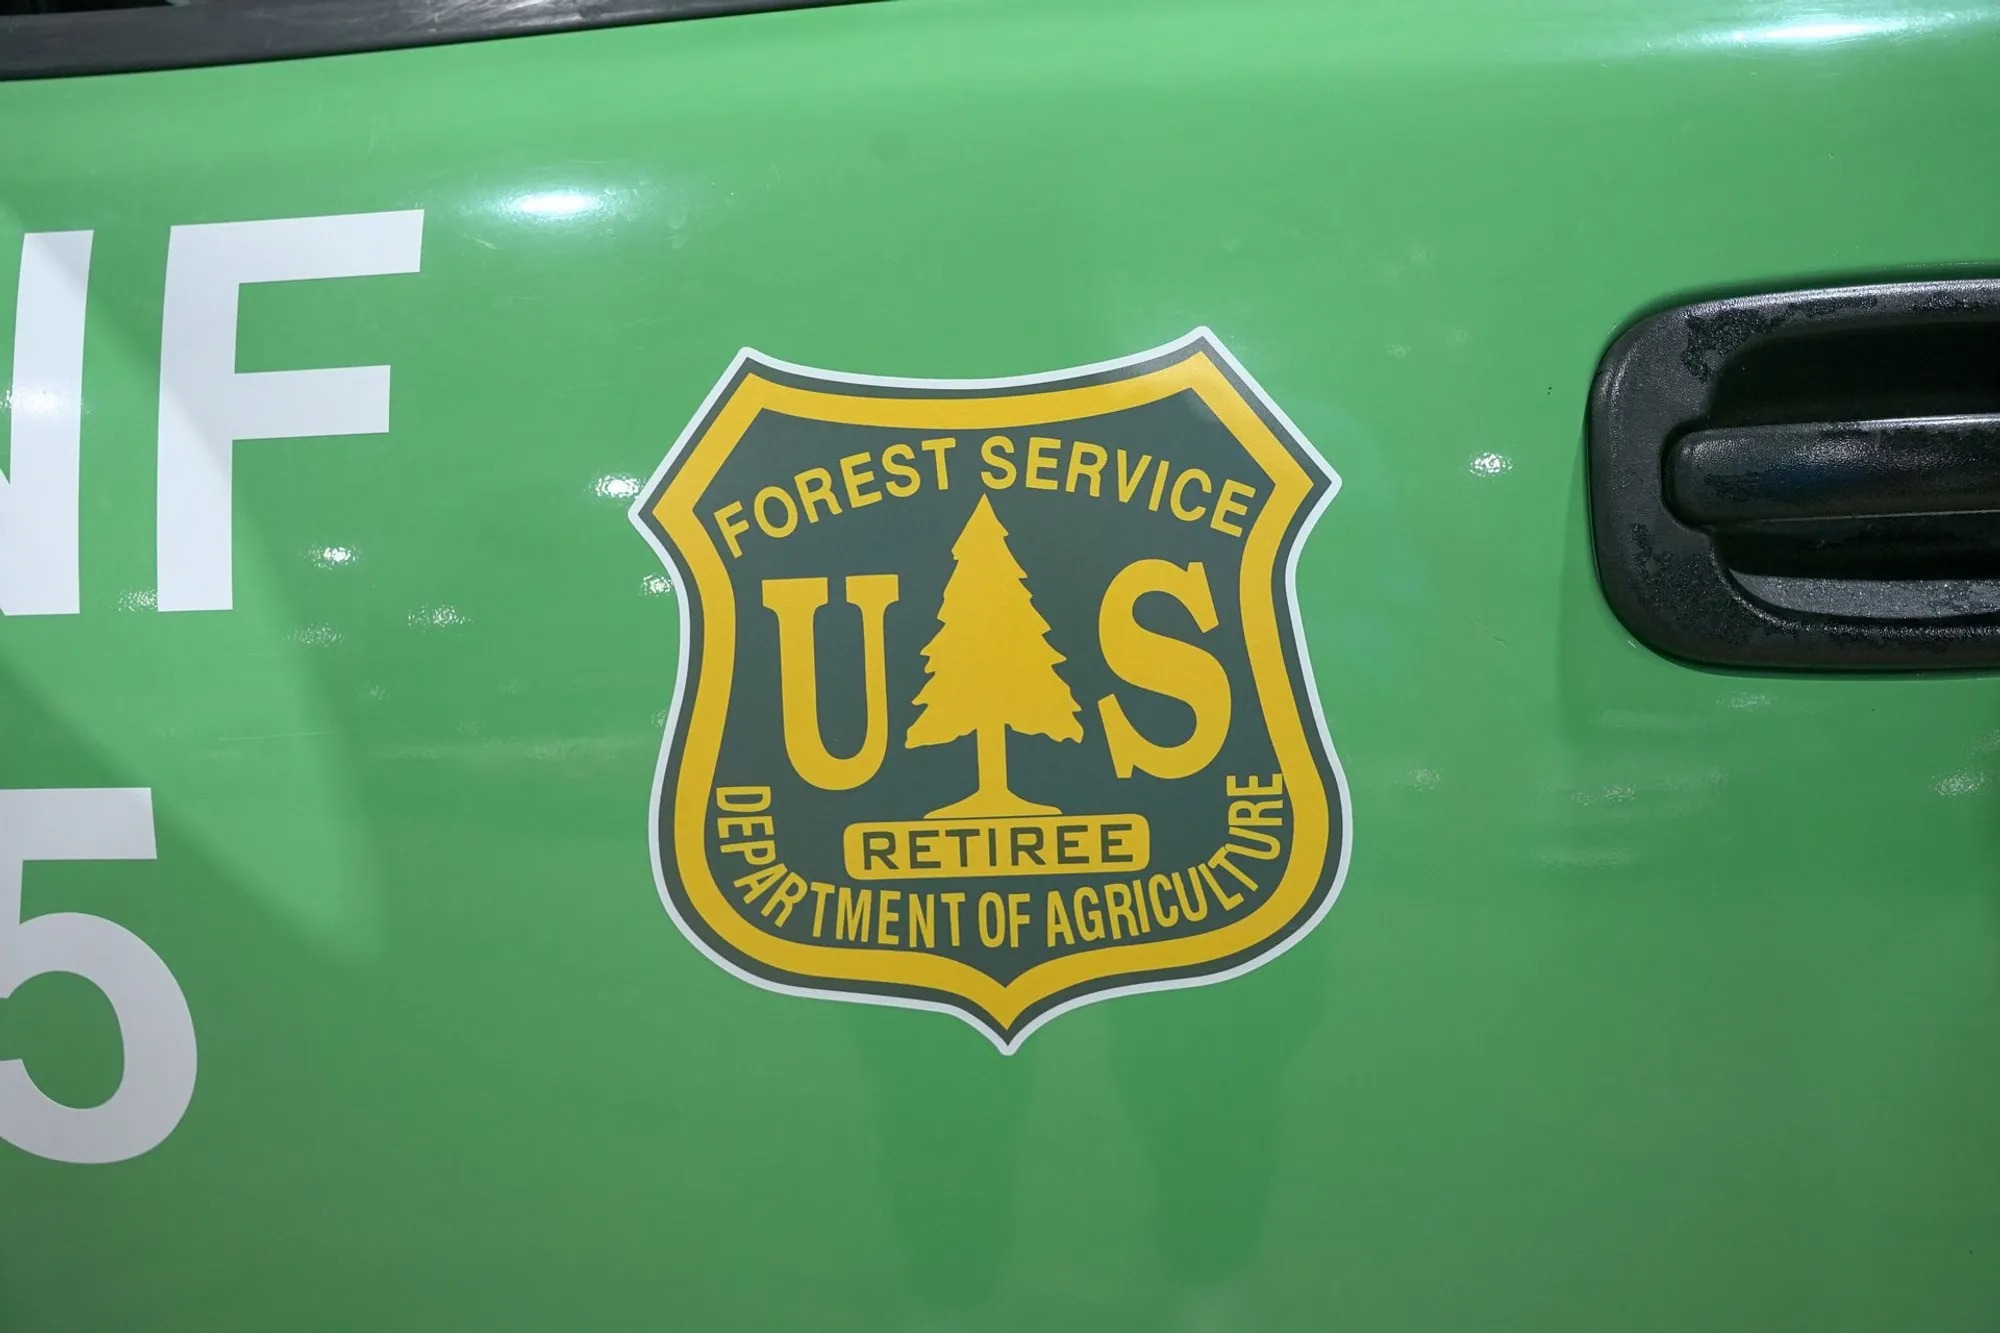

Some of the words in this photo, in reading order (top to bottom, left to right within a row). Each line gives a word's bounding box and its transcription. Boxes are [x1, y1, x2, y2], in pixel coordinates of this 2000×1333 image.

[713, 437, 956, 558] FOREST
[980, 435, 1256, 538] SERVICE
[715, 785, 967, 949] DEPARTMENT
[977, 891, 1032, 948] OF
[1046, 772, 1284, 948] AGRICULTURE
[861, 822, 1134, 871] RETIREE
[0, 786, 198, 1164] 5
